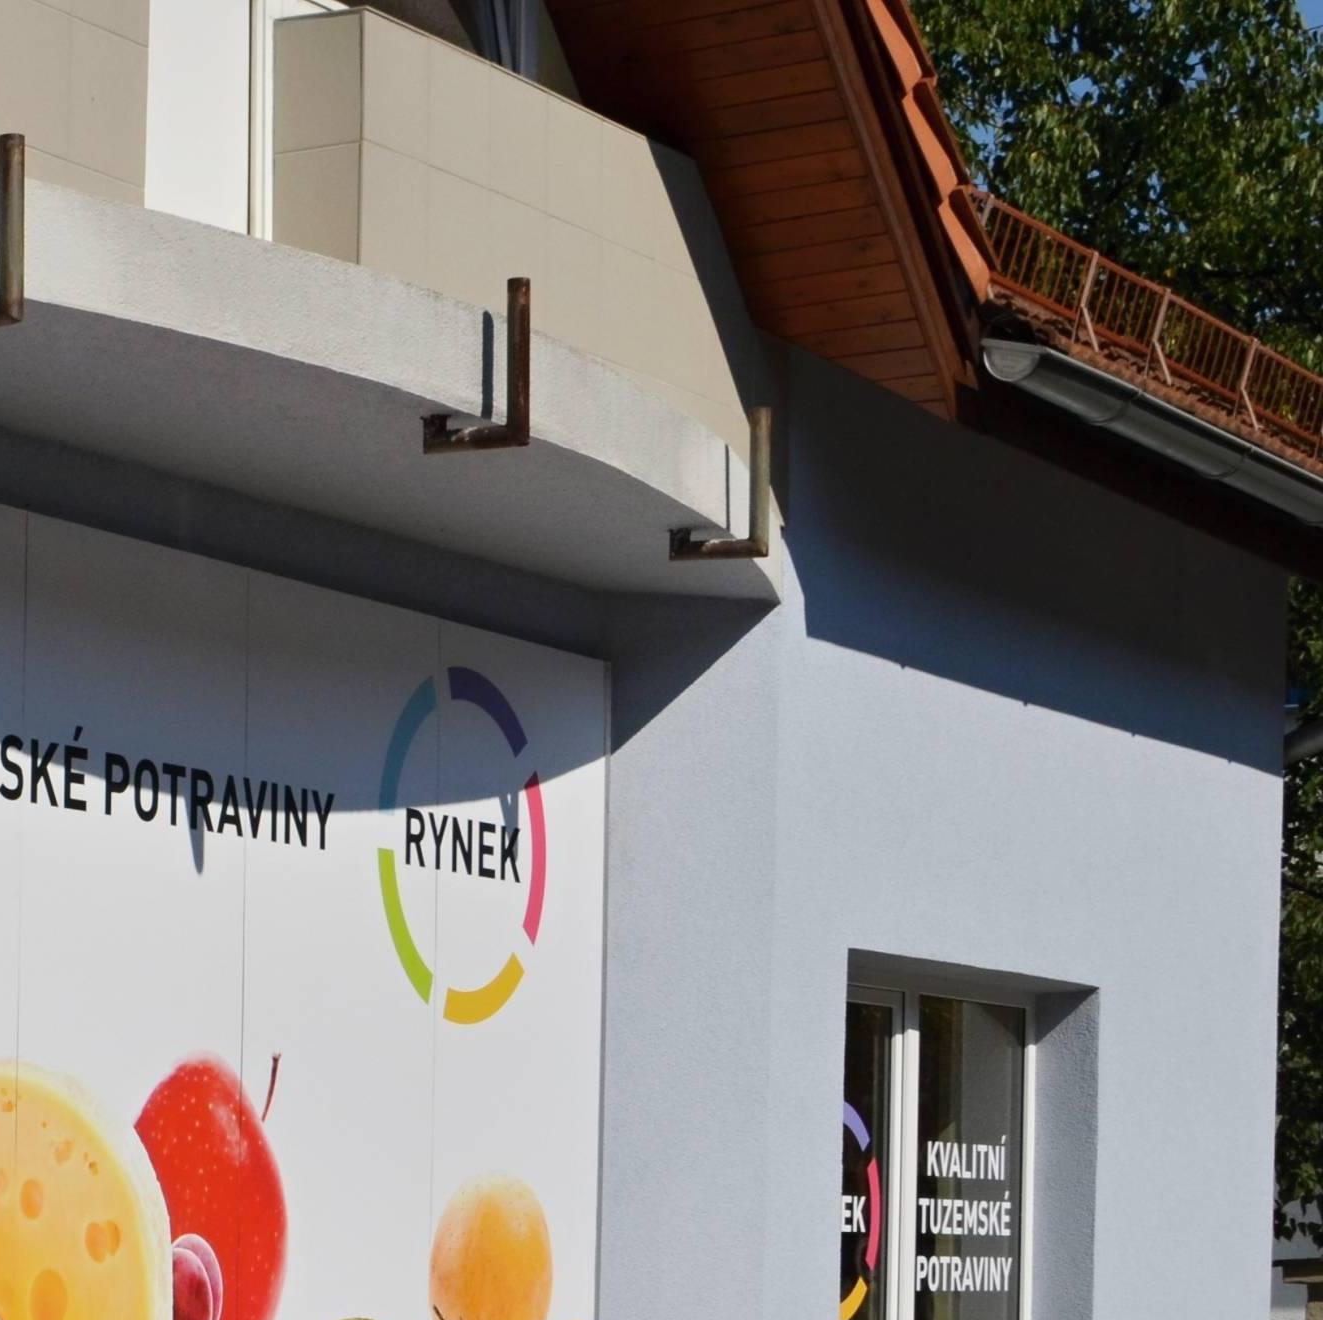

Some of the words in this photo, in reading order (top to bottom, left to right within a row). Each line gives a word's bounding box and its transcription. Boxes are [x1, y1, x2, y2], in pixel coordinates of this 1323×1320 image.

[104, 752, 335, 850] POTRAVINY
[405, 808, 522, 883] RYNEK
[926, 1134, 1007, 1181] KVALITNÍ
[918, 1191, 1012, 1236] TUZEMSKÉ
[915, 1255, 1013, 1292] POTRAVINY
